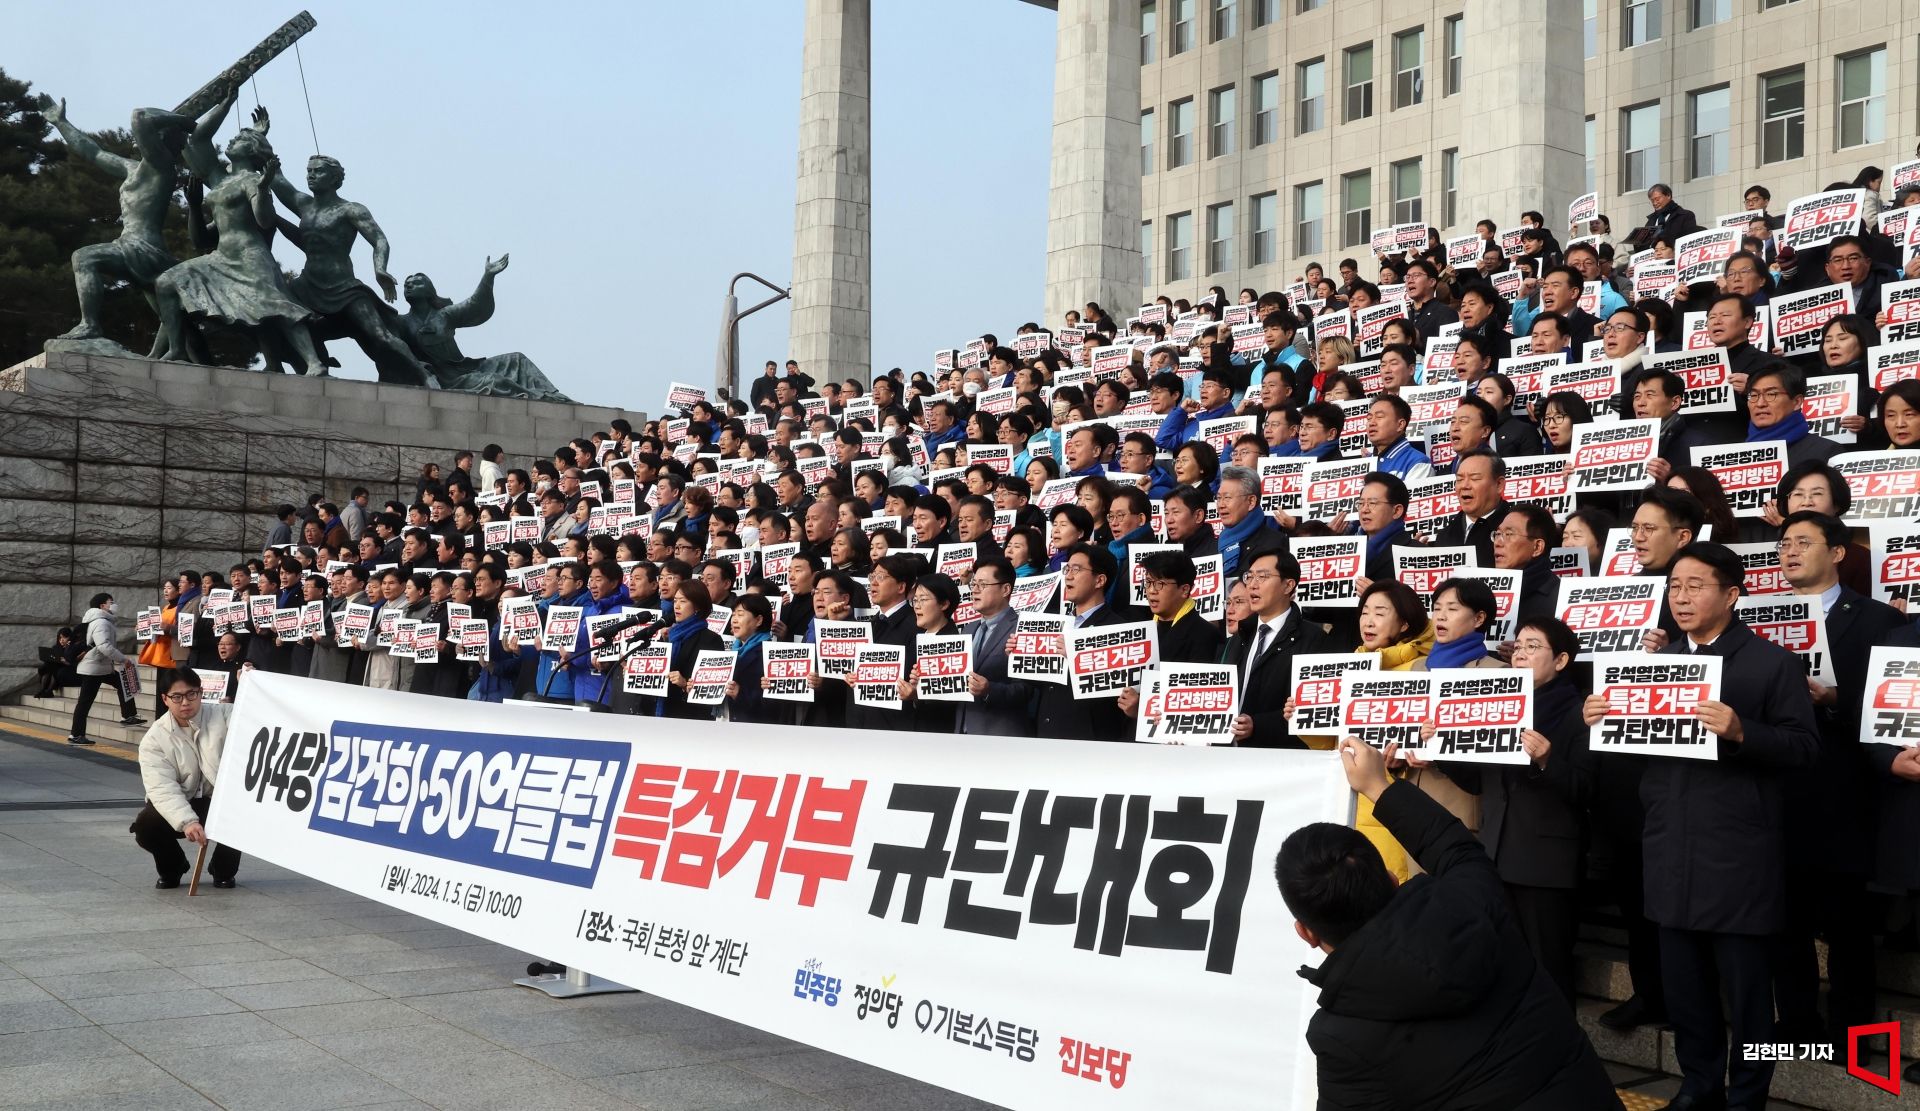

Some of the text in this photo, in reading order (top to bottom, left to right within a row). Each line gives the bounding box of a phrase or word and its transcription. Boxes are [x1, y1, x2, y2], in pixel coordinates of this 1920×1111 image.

[1792, 193, 1855, 216] 윤석열정권의
[1791, 204, 1851, 231] 특검 거부
[1680, 230, 1734, 253] 윤석열정권의
[1787, 220, 1855, 247] 규탄한다!
[1680, 243, 1731, 269] 특검 거부
[1778, 289, 1843, 315] 윤석열정권의
[1362, 306, 1401, 323] 윤석열정권의
[1550, 365, 1613, 385] 윤석열정권의
[1691, 369, 1720, 386] 거부
[980, 391, 1012, 403] 윤석열정권의
[1407, 387, 1461, 403] 윤석열정권의
[1411, 403, 1433, 420] 특검
[1808, 397, 1844, 416] 거부
[1581, 425, 1650, 443] 윤석열정권의
[970, 449, 1008, 459] 윤석열정권의
[1581, 441, 1651, 463] 김건희방탄
[1701, 447, 1778, 468] 윤석열정권의
[1311, 463, 1370, 481] 윤석열정권의
[1576, 463, 1649, 487] 거부한다!
[1264, 476, 1284, 492] 특검
[1312, 482, 1338, 500] 특검
[1503, 480, 1530, 499] 특검
[1871, 473, 1917, 494] 거부
[1406, 501, 1433, 519] 특검
[764, 547, 796, 561] 윤석열정권의
[943, 547, 974, 561] 윤석열정권의
[1297, 542, 1357, 559] 윤석열정권의
[765, 561, 776, 574] 특검
[1300, 556, 1355, 579] 특검 거부
[1400, 553, 1466, 569] 윤석열정권의
[1297, 578, 1358, 601] 규탄한다!
[1402, 573, 1431, 591] 특검
[1568, 583, 1655, 604] 윤석열정권의
[526, 615, 538, 626] 거부
[1566, 603, 1645, 629] 특검 거부
[820, 627, 866, 638] 윤석열정권의
[1074, 627, 1146, 651] 윤석열정권의
[918, 641, 965, 656] 윤석열정권의
[1016, 635, 1036, 653] 특검
[700, 656, 733, 667] 윤석열정권의
[768, 648, 809, 660] 윤석열정권의
[859, 651, 900, 662] 윤석열정권의
[1079, 644, 1145, 670] 특검 거부
[629, 660, 664, 673] 특검 거부
[769, 661, 807, 676] 특검 거부
[857, 666, 898, 680] 김건희방탄
[920, 655, 963, 674] 특검 거부
[1013, 656, 1064, 674] 규탄한다!
[1605, 663, 1707, 684] 윤석열정권의
[627, 675, 665, 689] 규탄한다!
[769, 679, 809, 694] 규탄한다!
[921, 676, 970, 695] 규탄한다!
[1168, 671, 1230, 686] 윤석열정권의
[1440, 677, 1522, 697] 윤석열정권의
[857, 684, 898, 701] 거부한다!
[1300, 681, 1333, 703] 특검
[1351, 680, 1430, 697] 윤석열정권의
[1167, 691, 1230, 710] 김건희방탄
[1610, 687, 1699, 712] 특검 거부
[1352, 701, 1389, 723] 특검
[1391, 699, 1427, 721] 거부
[1439, 704, 1521, 724] 김건희방탄
[1165, 713, 1234, 734] 거부한다!
[1601, 717, 1707, 745] 규탄한다!
[1439, 728, 1523, 754] 거부한다!
[244, 727, 328, 812] 야4당
[866, 782, 1264, 975] 규탄대회
[622, 919, 655, 955] 국회
[654, 925, 690, 962] 본청
[689, 934, 710, 967] 앞
[710, 939, 748, 976] 계단
[794, 969, 841, 1007] 민주당
[854, 984, 903, 1029] 정의당
[934, 1005, 1039, 1062] 기본소득당
[1058, 1036, 1131, 1089] 진보당
